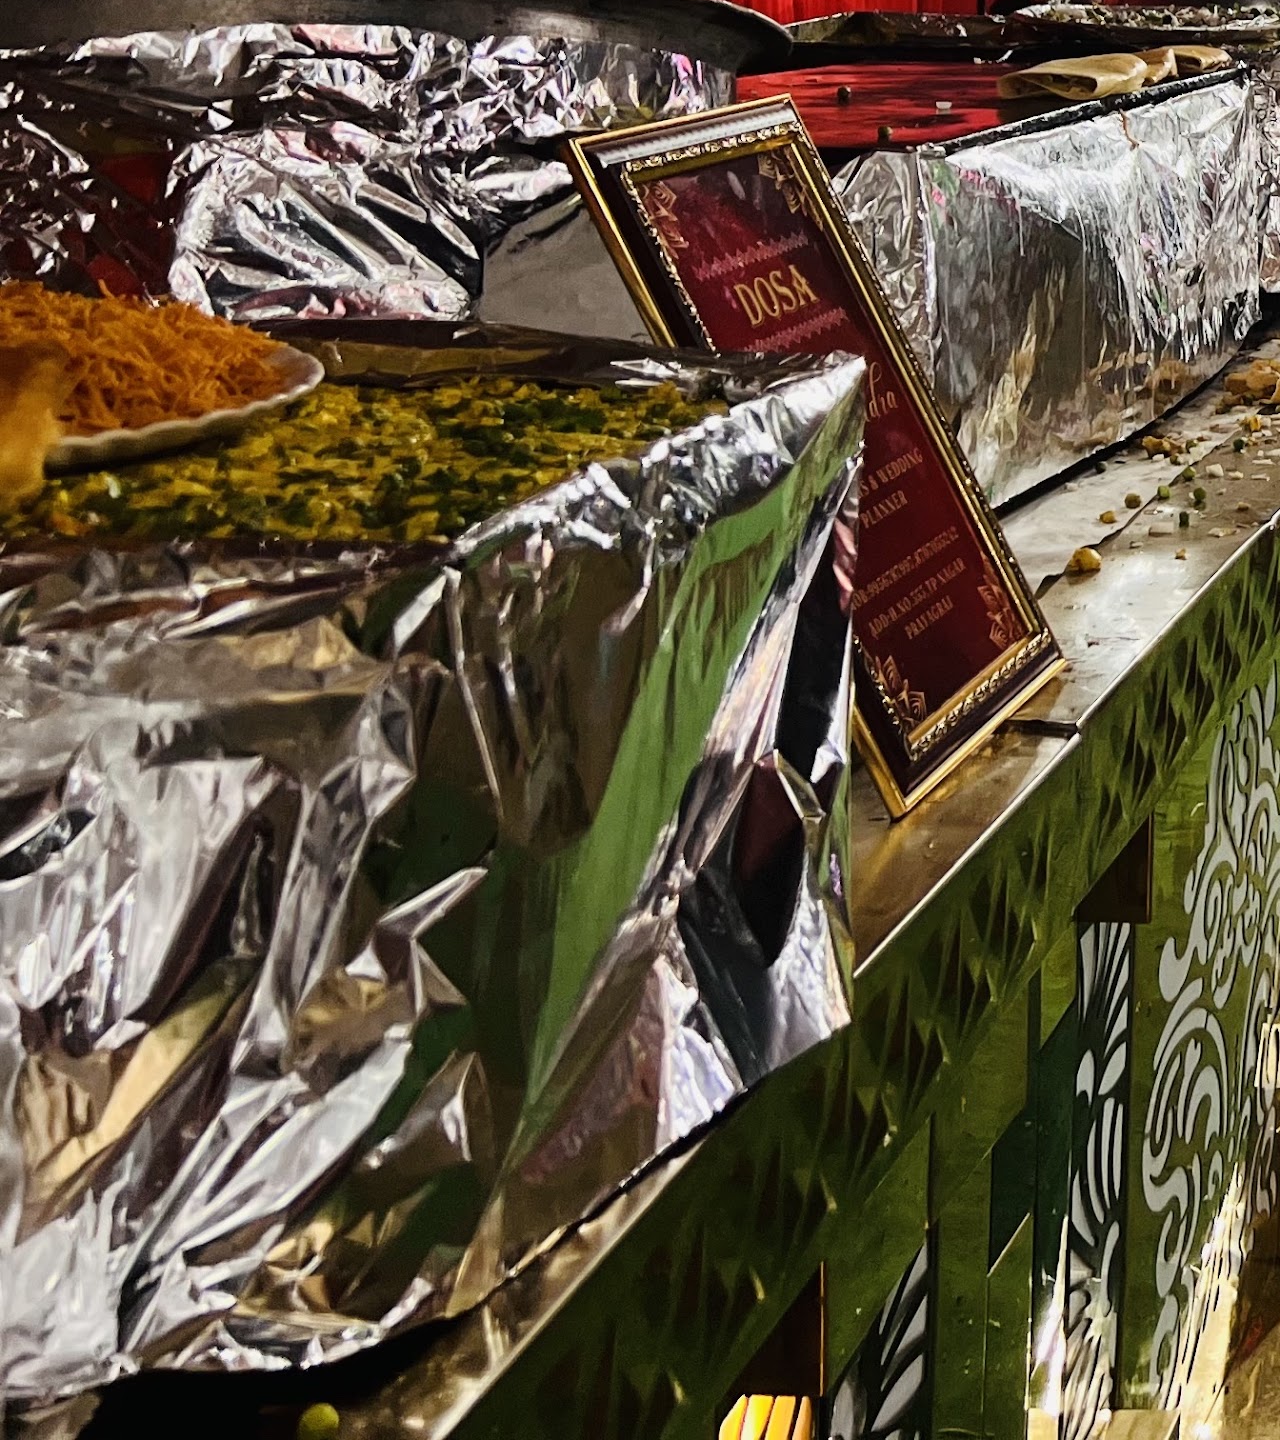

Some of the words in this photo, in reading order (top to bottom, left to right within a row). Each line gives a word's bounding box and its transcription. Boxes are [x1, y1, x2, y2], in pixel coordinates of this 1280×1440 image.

[733, 264, 820, 328] DOSA
[876, 447, 924, 483] WEDDING
[860, 489, 908, 529] PLANNER
